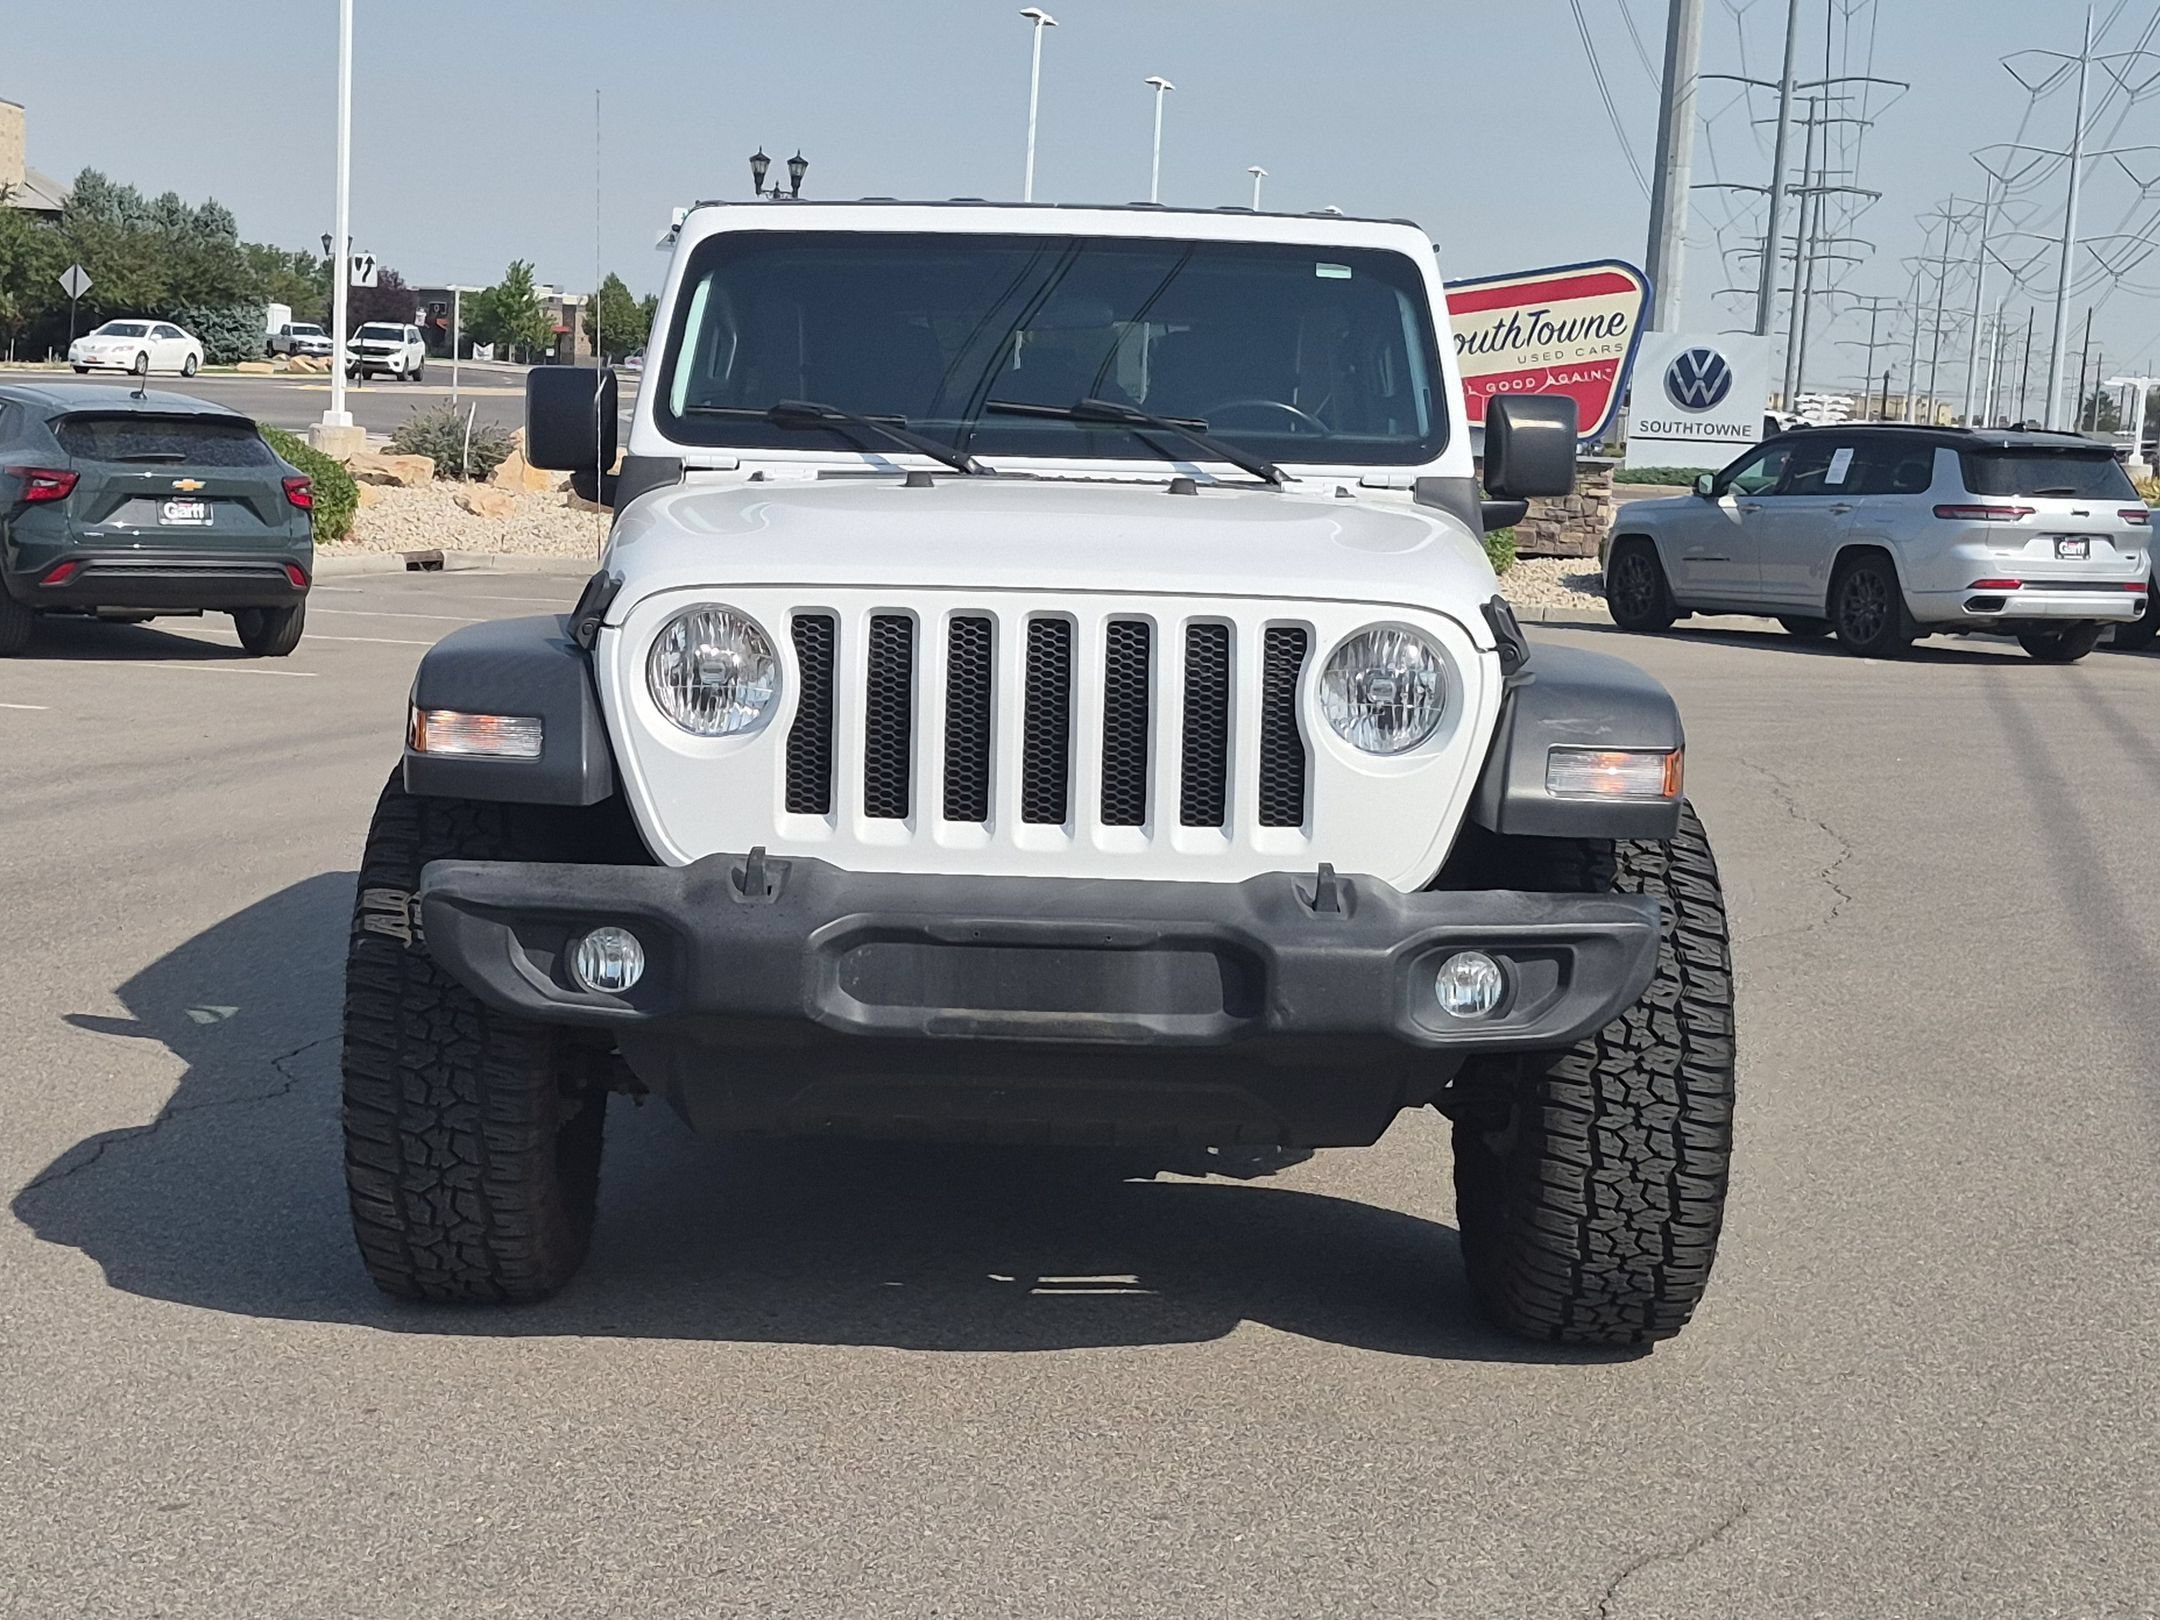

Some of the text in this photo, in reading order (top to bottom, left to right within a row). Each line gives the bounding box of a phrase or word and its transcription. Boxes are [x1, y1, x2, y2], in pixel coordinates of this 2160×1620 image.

[1454, 309, 1627, 356] outhTowne
[1517, 343, 1624, 364] USED CARS
[1486, 377, 1536, 393] GOOD
[1639, 420, 1753, 437] SOUTHTOWNE
